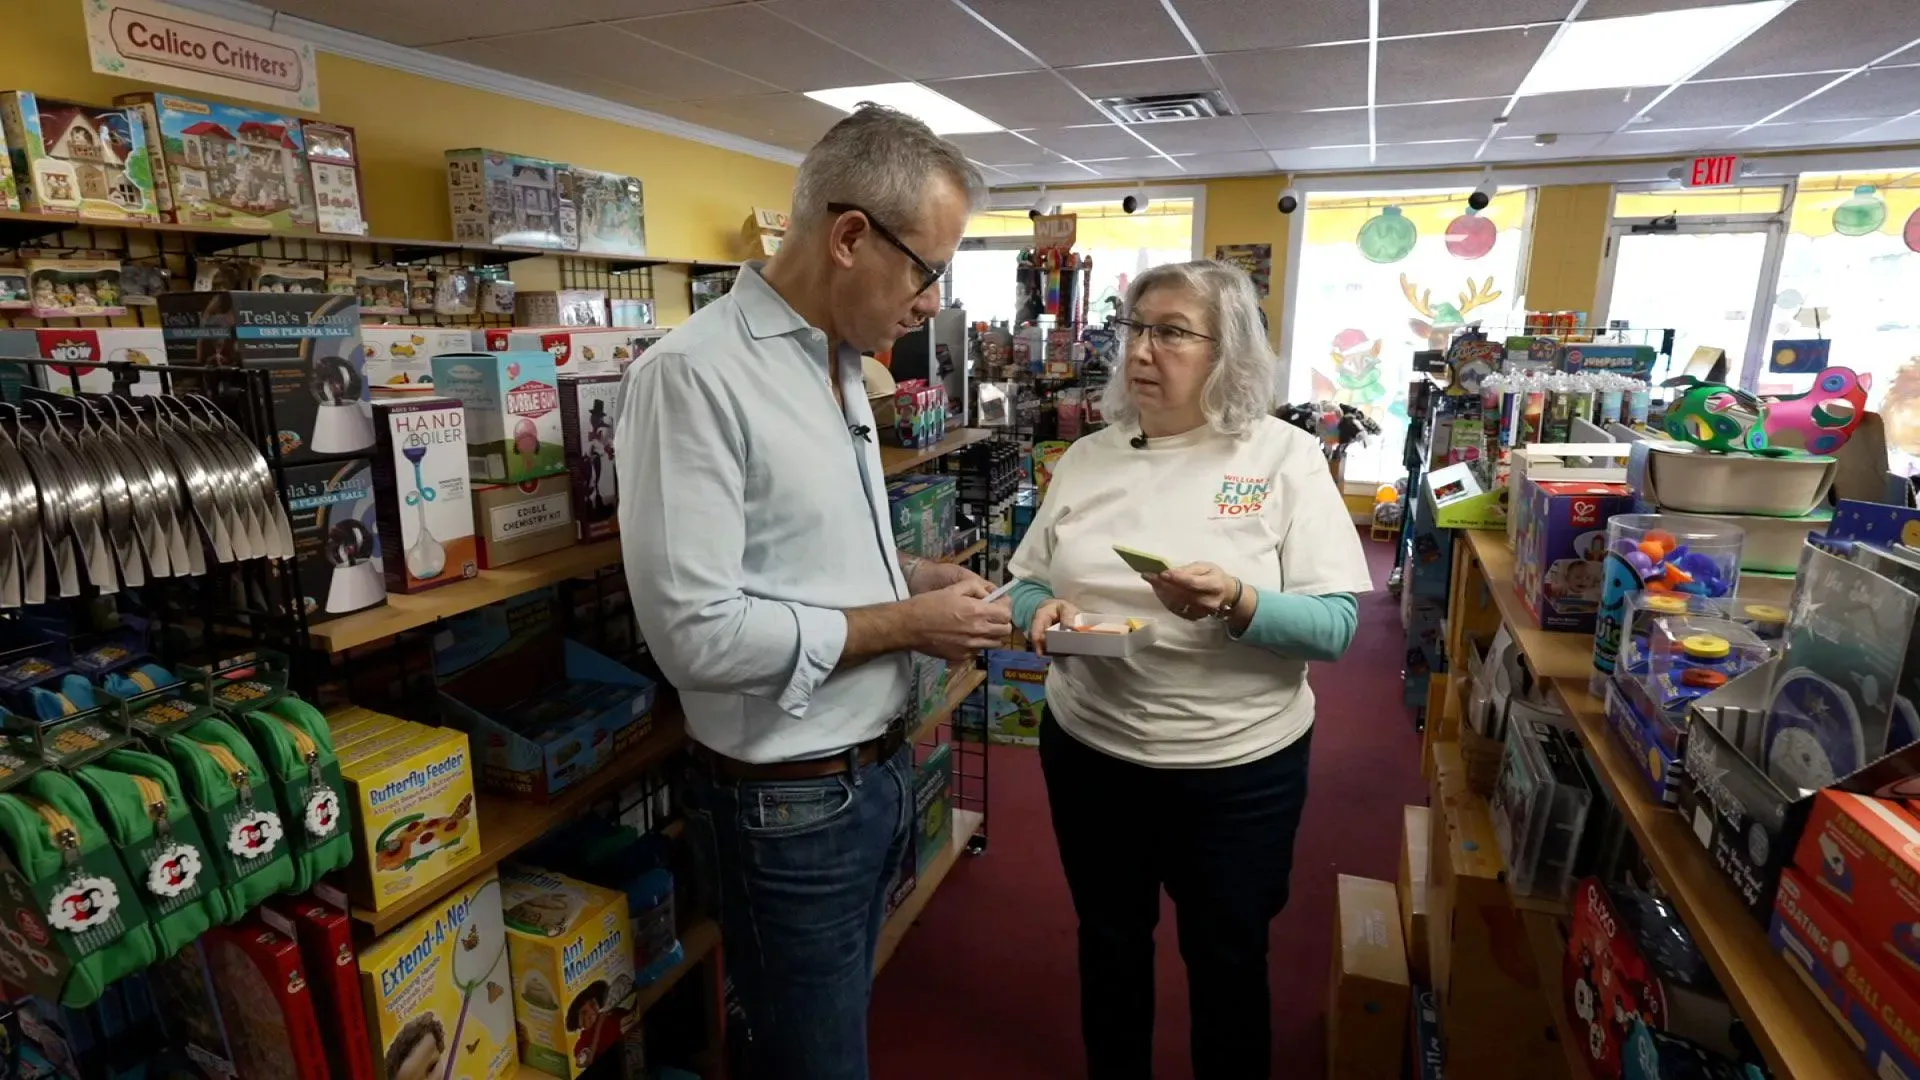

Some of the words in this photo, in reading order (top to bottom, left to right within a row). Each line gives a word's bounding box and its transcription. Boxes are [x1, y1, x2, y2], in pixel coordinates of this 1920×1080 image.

[127, 21, 207, 60] Calico
[212, 40, 288, 78] Critters
[1691, 155, 1736, 186] EXIT
[1037, 219, 1074, 238] WILD
[240, 310, 299, 325] Tesla's
[307, 309, 352, 326] Lamp
[282, 327, 324, 336] PLASMA
[326, 327, 350, 336] BALL
[50, 346, 92, 360] WOW
[395, 412, 462, 432] HAND
[410, 428, 461, 447] BOILER
[1213, 491, 1271, 505] SMART
[1221, 481, 1268, 496] FUN
[517, 503, 547, 518] EDIBLE
[1217, 501, 1262, 515] TOYS
[503, 514, 547, 532] CHEMISTRY
[548, 510, 561, 520] KIT
[1572, 515, 1595, 523] Hape
[369, 770, 426, 806] Butterfly
[426, 752, 464, 778] Feeder
[563, 935, 585, 966] Ant
[563, 929, 622, 985] Mountain
[1777, 887, 1830, 954] FLOATING
[1844, 963, 1881, 1011] BALL
